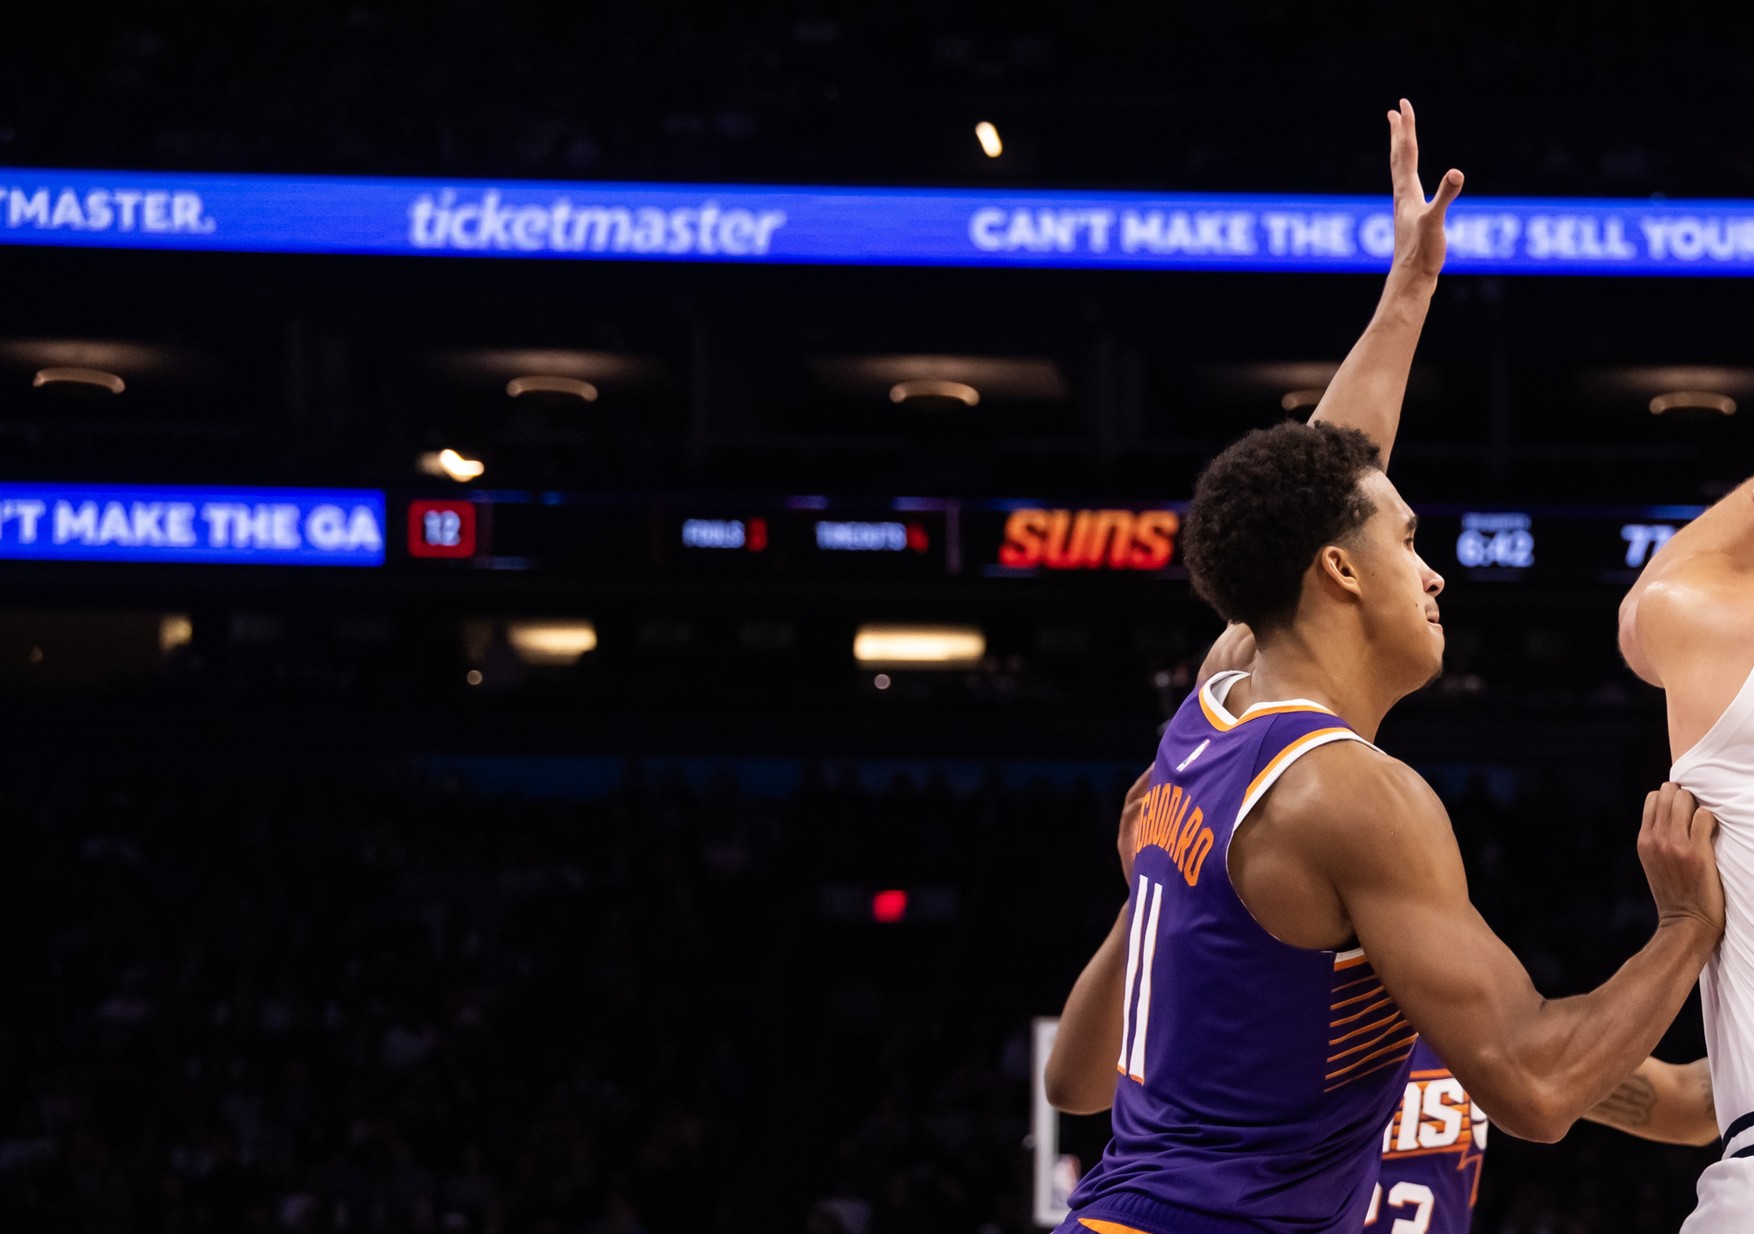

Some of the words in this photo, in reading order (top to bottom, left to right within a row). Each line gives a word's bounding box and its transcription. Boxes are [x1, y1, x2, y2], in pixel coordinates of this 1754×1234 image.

[0, 188, 216, 233] MASTER.
[410, 190, 786, 254] ticketmaster
[969, 207, 1114, 252] CAN'T
[1120, 211, 1256, 255] MAKE
[1263, 212, 1354, 256] THE
[1526, 215, 1635, 260] SELL
[54, 503, 196, 546] MAKE
[204, 504, 300, 548] THE
[1000, 509, 1178, 569] SUNS
[1117, 874, 1163, 1086] 11
